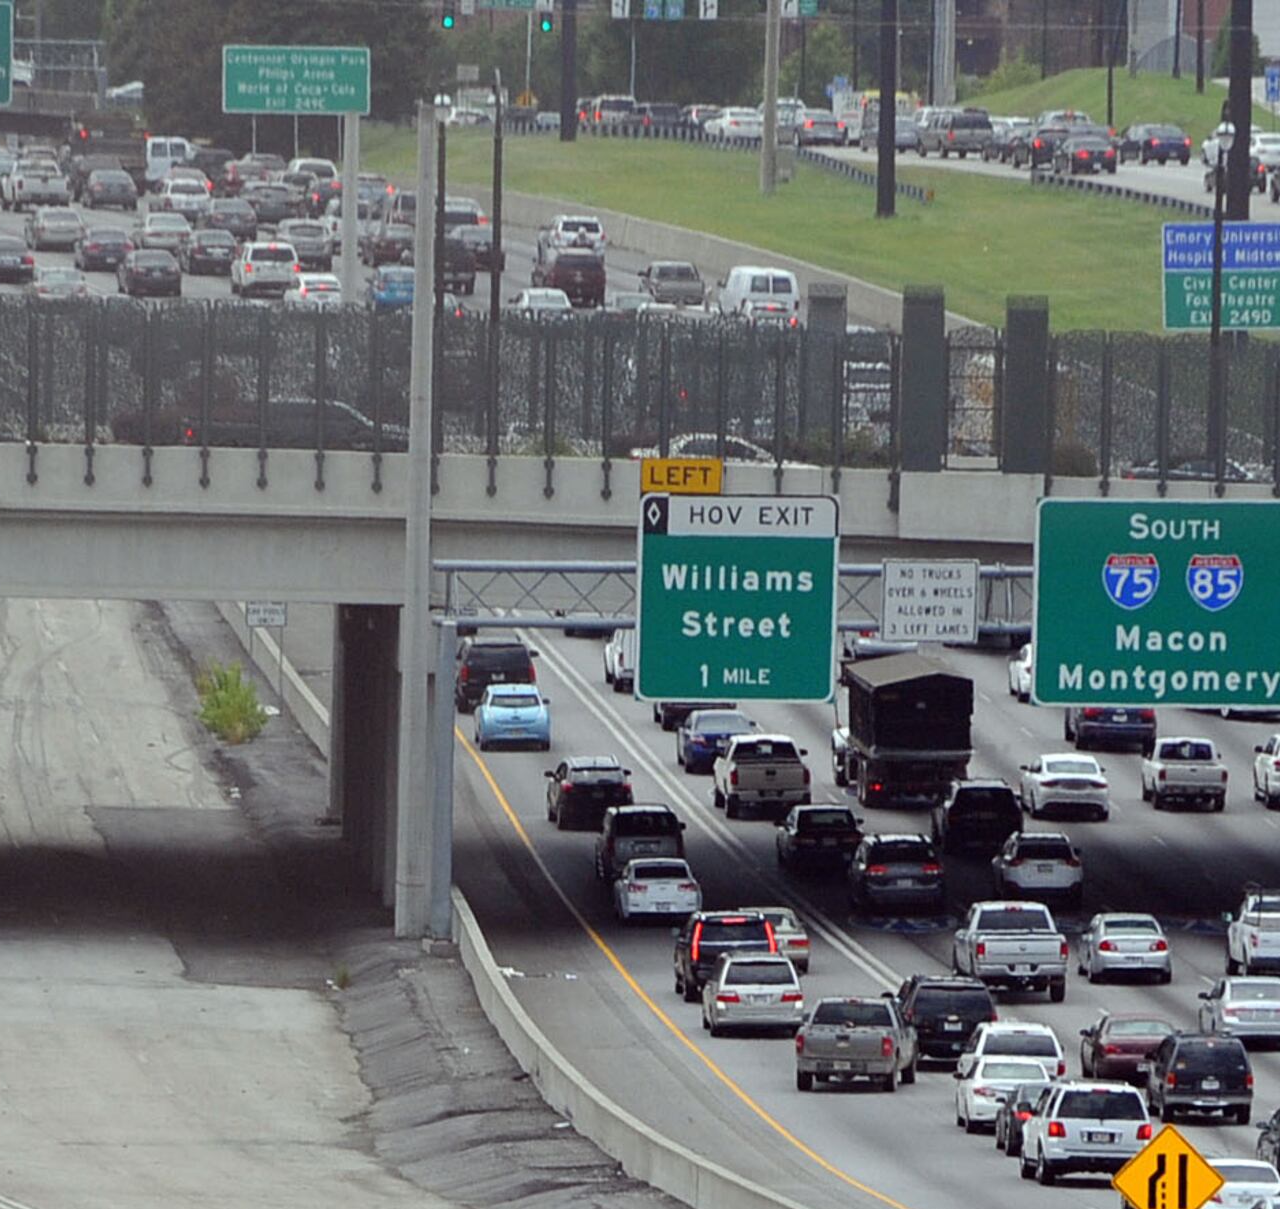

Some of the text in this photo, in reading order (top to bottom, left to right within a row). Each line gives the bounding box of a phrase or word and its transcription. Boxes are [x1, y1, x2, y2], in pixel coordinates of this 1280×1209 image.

[1166, 230, 1212, 245] Emory
[1183, 276, 1277, 290] Civi Center
[1186, 293, 1275, 306] Fox Theatre
[1190, 310, 1272, 324] EXI 249D
[650, 466, 712, 486] LEFT
[689, 505, 814, 526] HOV EXIT
[662, 563, 814, 592] Williams
[900, 568, 961, 580] NO TRUCKS
[888, 587, 914, 598] OVER
[933, 587, 973, 598] WHEELS
[1109, 568, 1237, 600] 75 85
[898, 606, 962, 617] ALLOWED IN
[681, 610, 791, 638] Street
[904, 624, 927, 635] LEFT
[936, 624, 968, 635] LANES
[1115, 625, 1227, 651] Macon
[700, 663, 771, 688] 1 MILE
[1059, 664, 1280, 698] Montgomery
